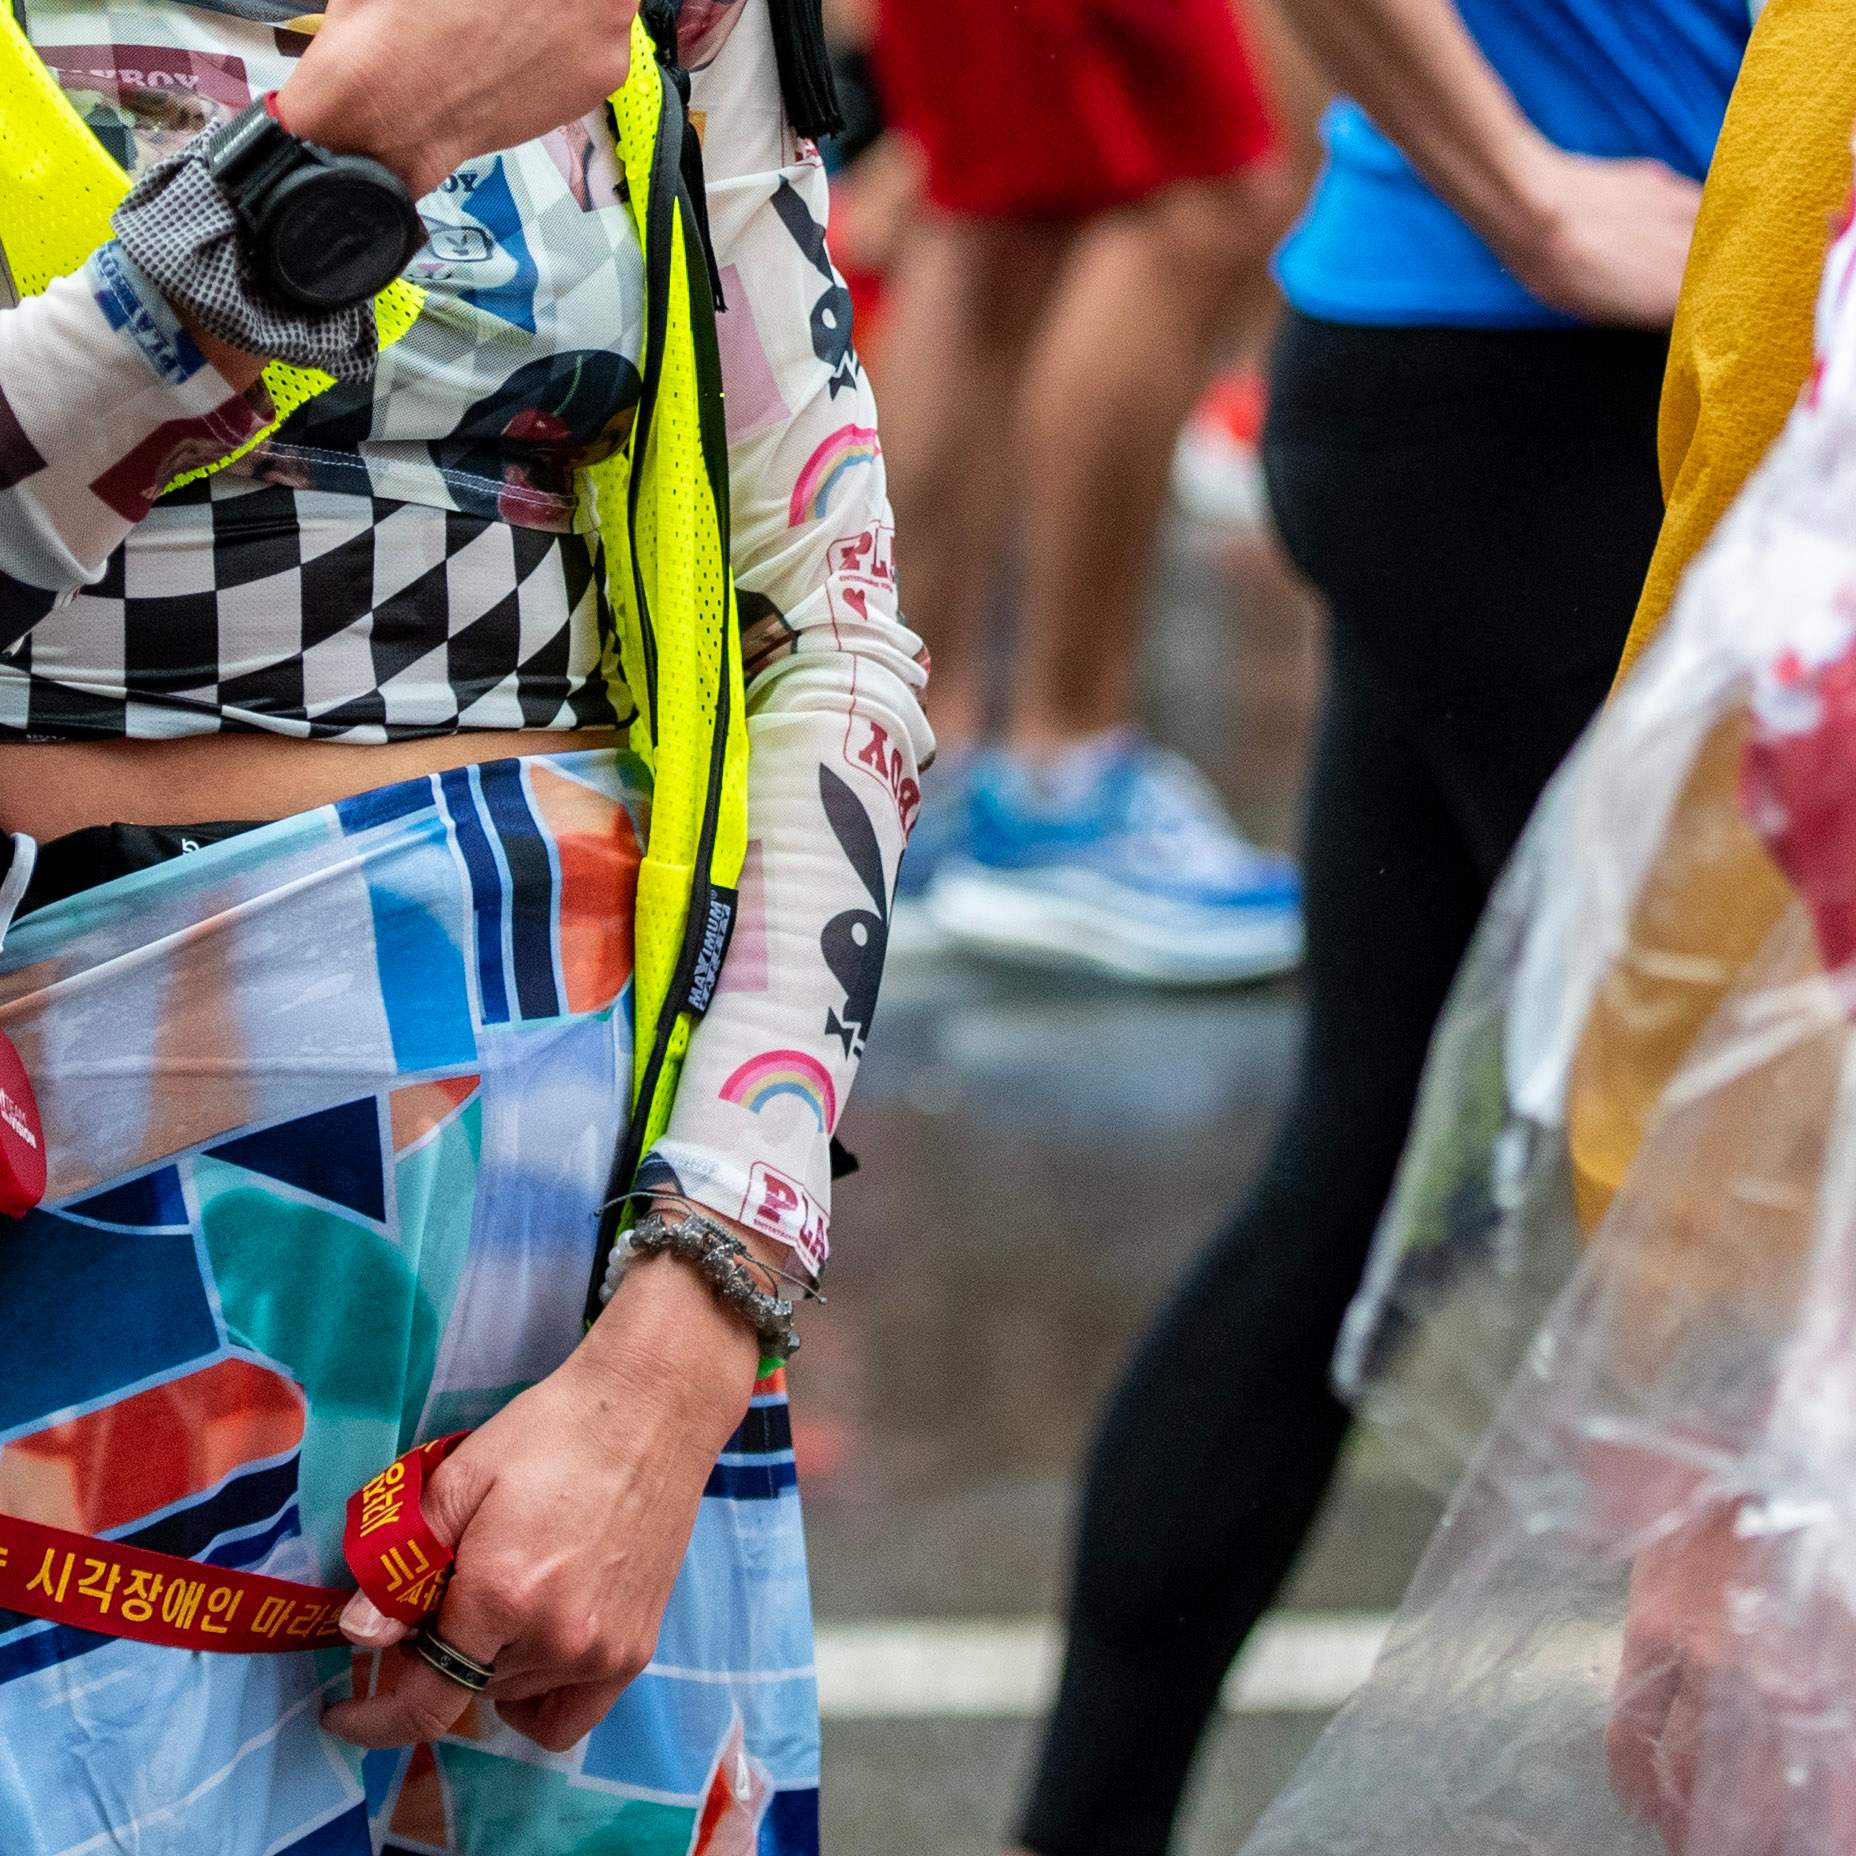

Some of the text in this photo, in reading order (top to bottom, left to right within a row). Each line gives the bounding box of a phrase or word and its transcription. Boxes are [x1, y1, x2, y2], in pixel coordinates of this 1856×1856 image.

[840, 531, 896, 583] PL
[687, 900, 724, 1006] MAXIMUM
[26, 1547, 244, 1634] 시각장애인
